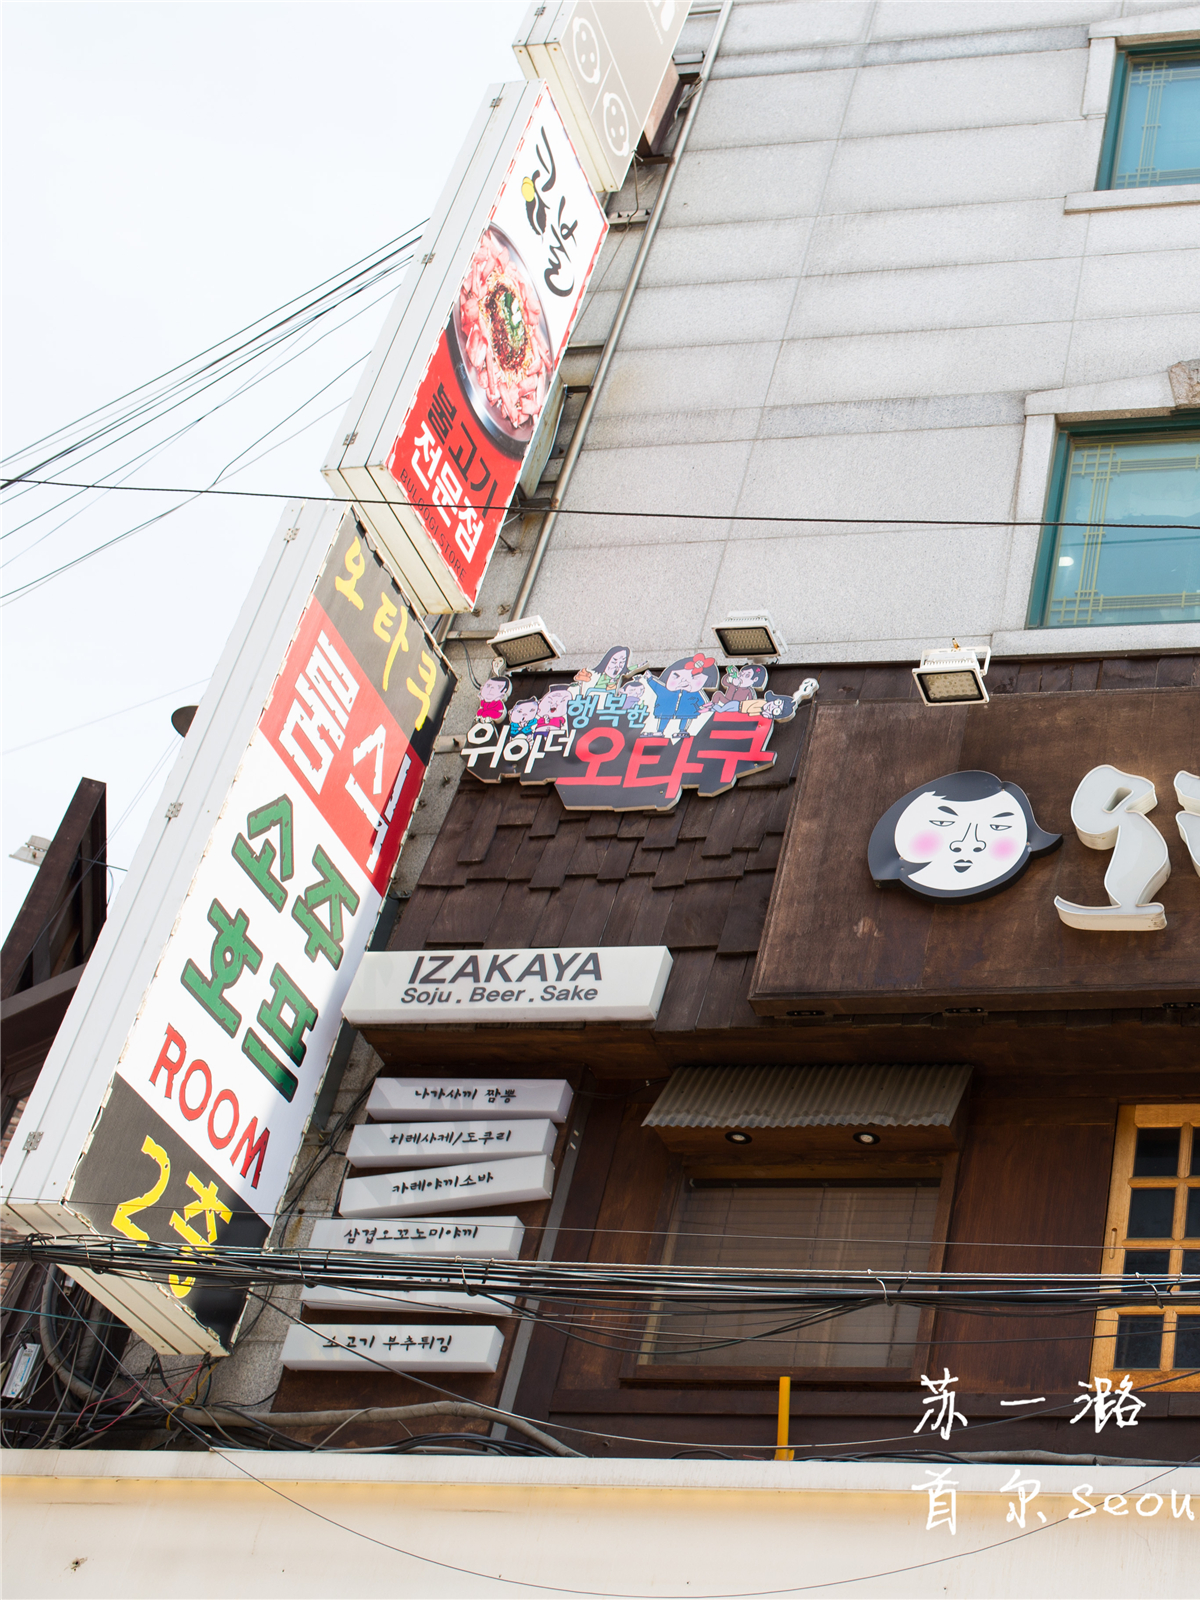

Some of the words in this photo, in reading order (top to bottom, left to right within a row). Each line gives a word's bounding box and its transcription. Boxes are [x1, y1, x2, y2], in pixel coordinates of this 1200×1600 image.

[411, 420, 484, 564] 전문점
[428, 382, 498, 519] 불고기
[438, 534, 467, 583] STORE
[335, 536, 437, 731] 오타쿠
[568, 689, 650, 728] 행복한
[460, 723, 578, 774] 위아더
[555, 711, 776, 799] 오타쿠
[231, 793, 361, 971] 소주
[181, 898, 319, 1103] 호프
[408, 953, 603, 984] IZAKAYA
[540, 985, 599, 1002] Sake
[149, 1023, 270, 1190] ROOM
[415, 1088, 478, 1100] 나가사끼
[111, 1135, 233, 1299] 2층
[392, 1171, 494, 1194] 카레야끼소바
[322, 1335, 376, 1349] 소고기
